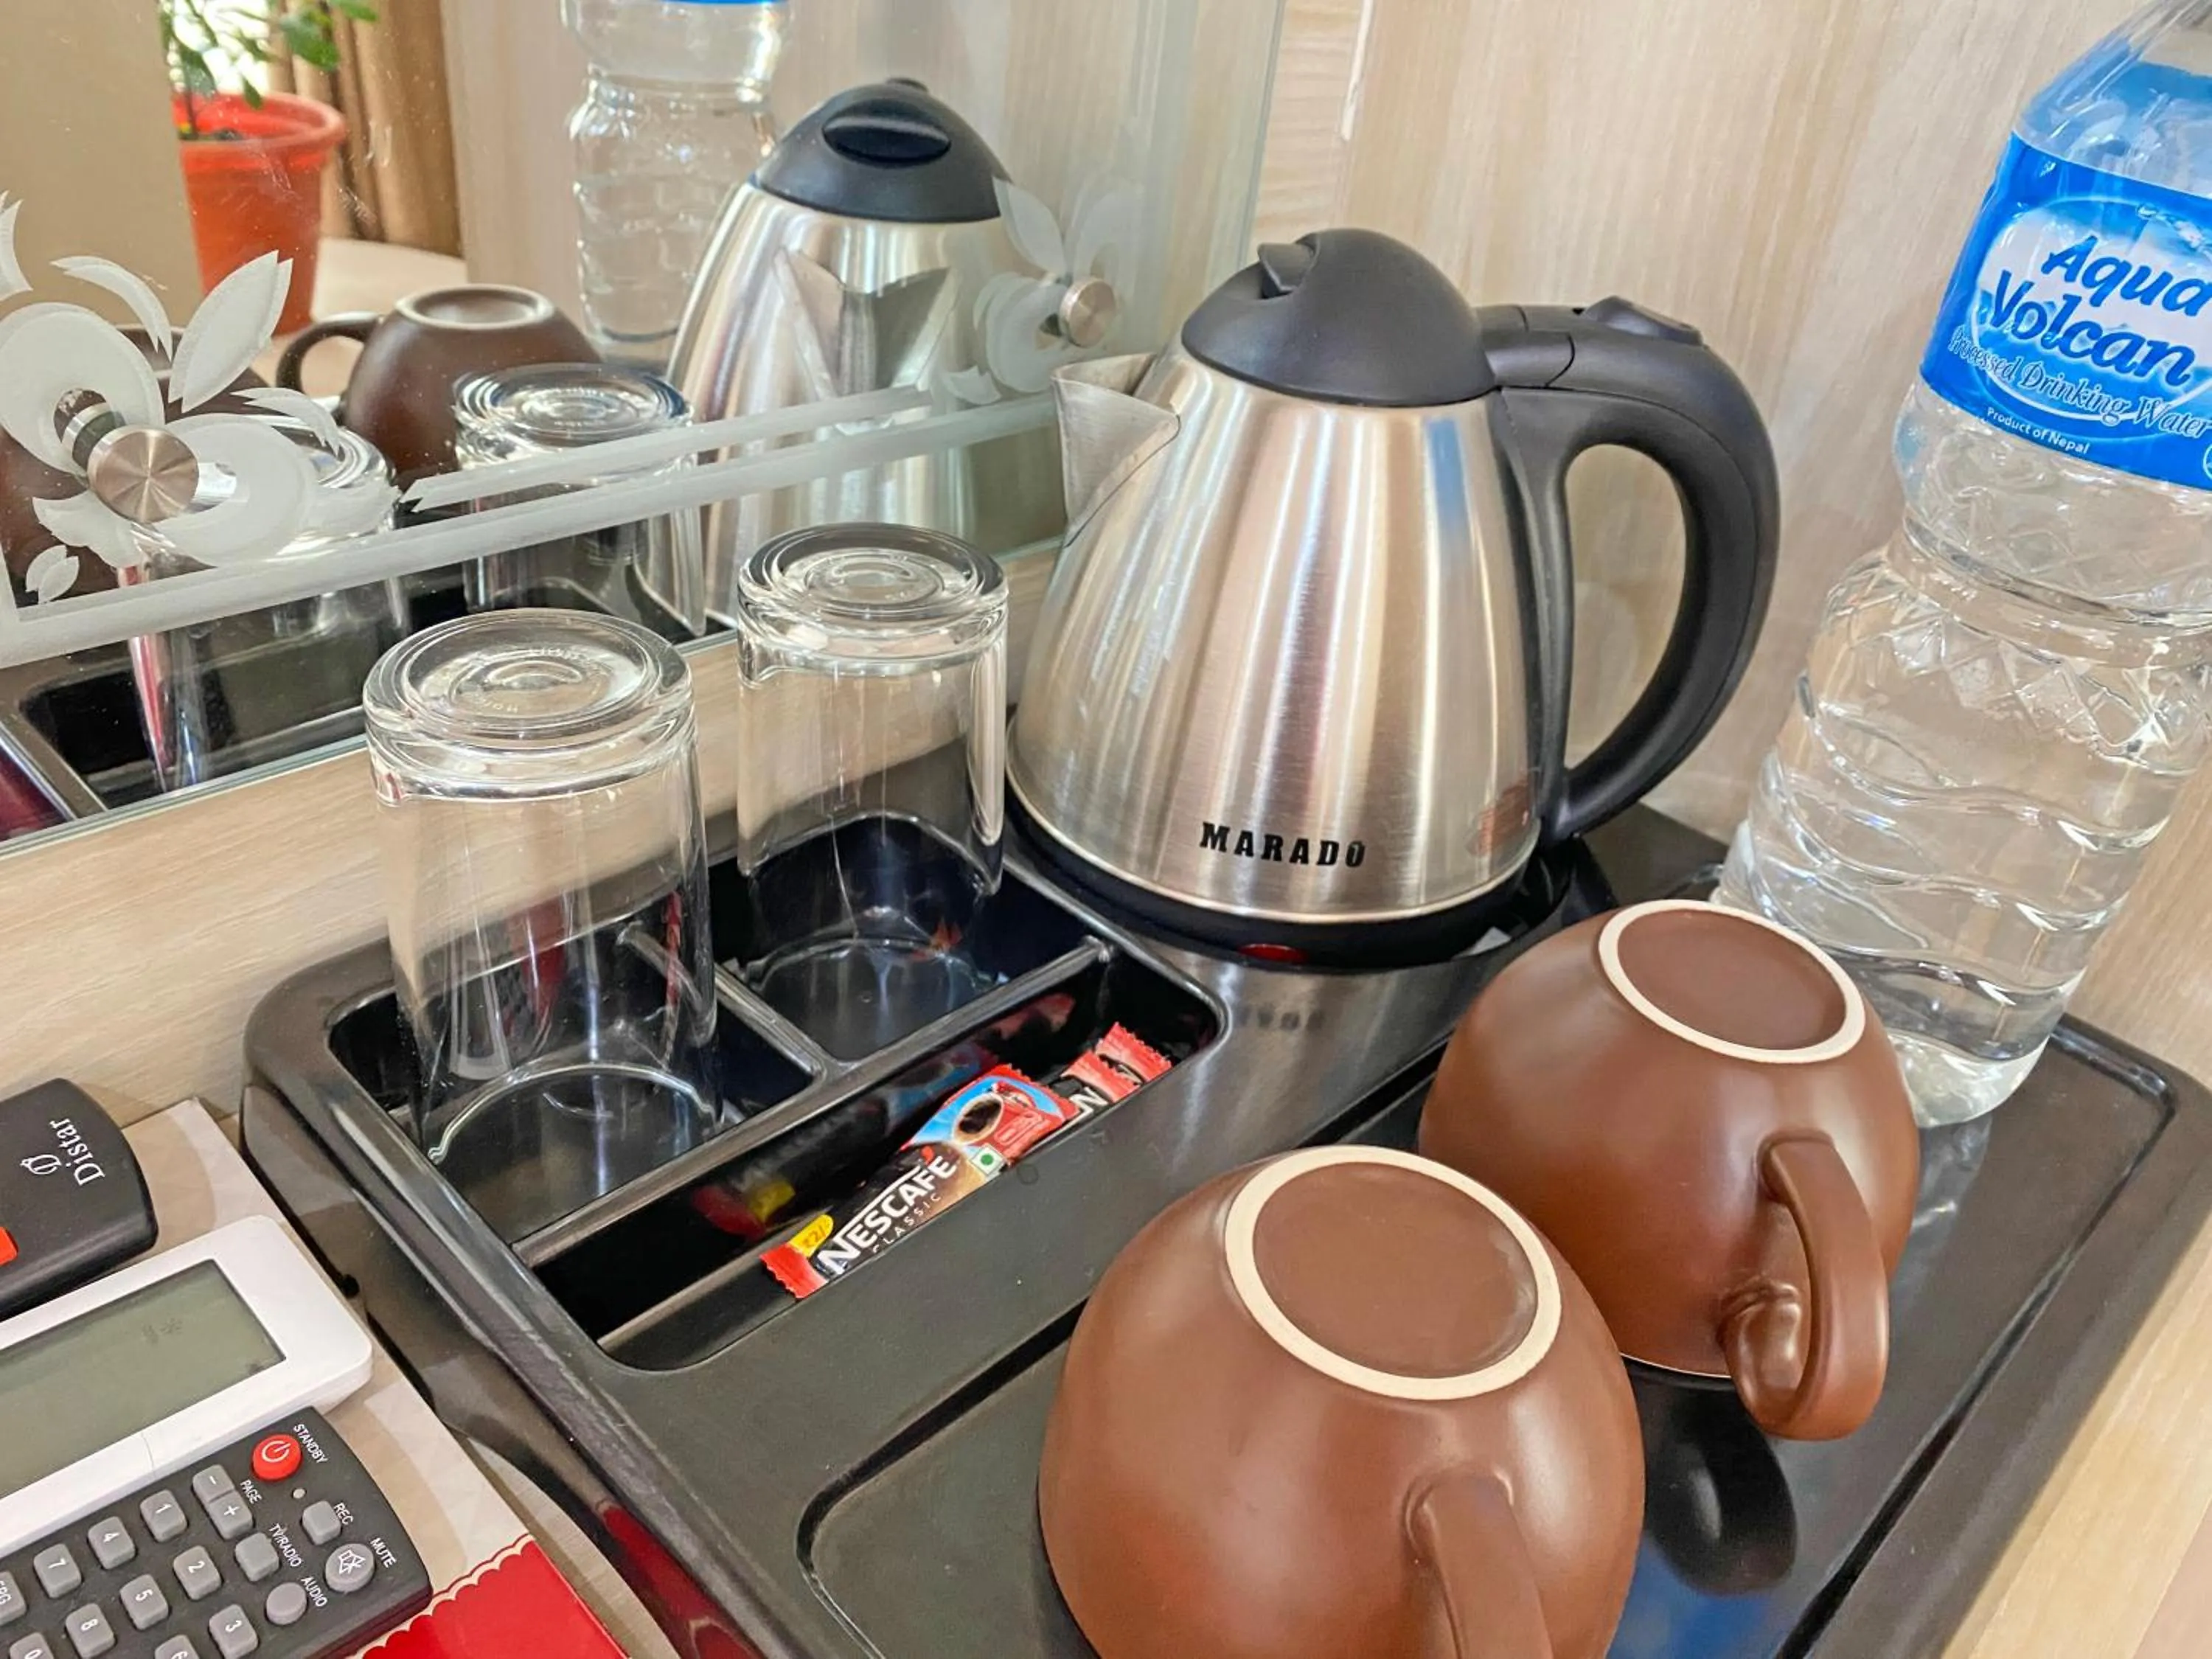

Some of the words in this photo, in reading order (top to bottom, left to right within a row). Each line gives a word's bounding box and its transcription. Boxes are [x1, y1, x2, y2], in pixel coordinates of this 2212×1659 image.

[2040, 234, 2212, 317] Aqua
[1991, 270, 2196, 387] Volcan
[1948, 324, 2024, 383] Processed
[2018, 361, 2132, 426] Drinking
[2133, 396, 2212, 438] Water
[1986, 407, 2031, 434] Product
[2033, 428, 2047, 440] of
[2048, 431, 2091, 454] Nepal
[1199, 821, 1366, 868] MARADO
[49, 1118, 105, 1186] Distar
[872, 1194, 941, 1253] CLASSIC
[293, 1423, 329, 1464] STANDBY
[240, 1479, 262, 1504] PAGE
[333, 1502, 354, 1526] REC
[102, 1531, 120, 1543] 4
[268, 1523, 302, 1568] TV/RADIO
[369, 1537, 397, 1568] MUTE
[46, 1557, 67, 1570] 7
[187, 1559, 206, 1573] 2
[135, 1588, 154, 1602] 5
[300, 1576, 328, 1607] AUDIO
[80, 1618, 99, 1632] 8
[224, 1619, 243, 1632] 3
